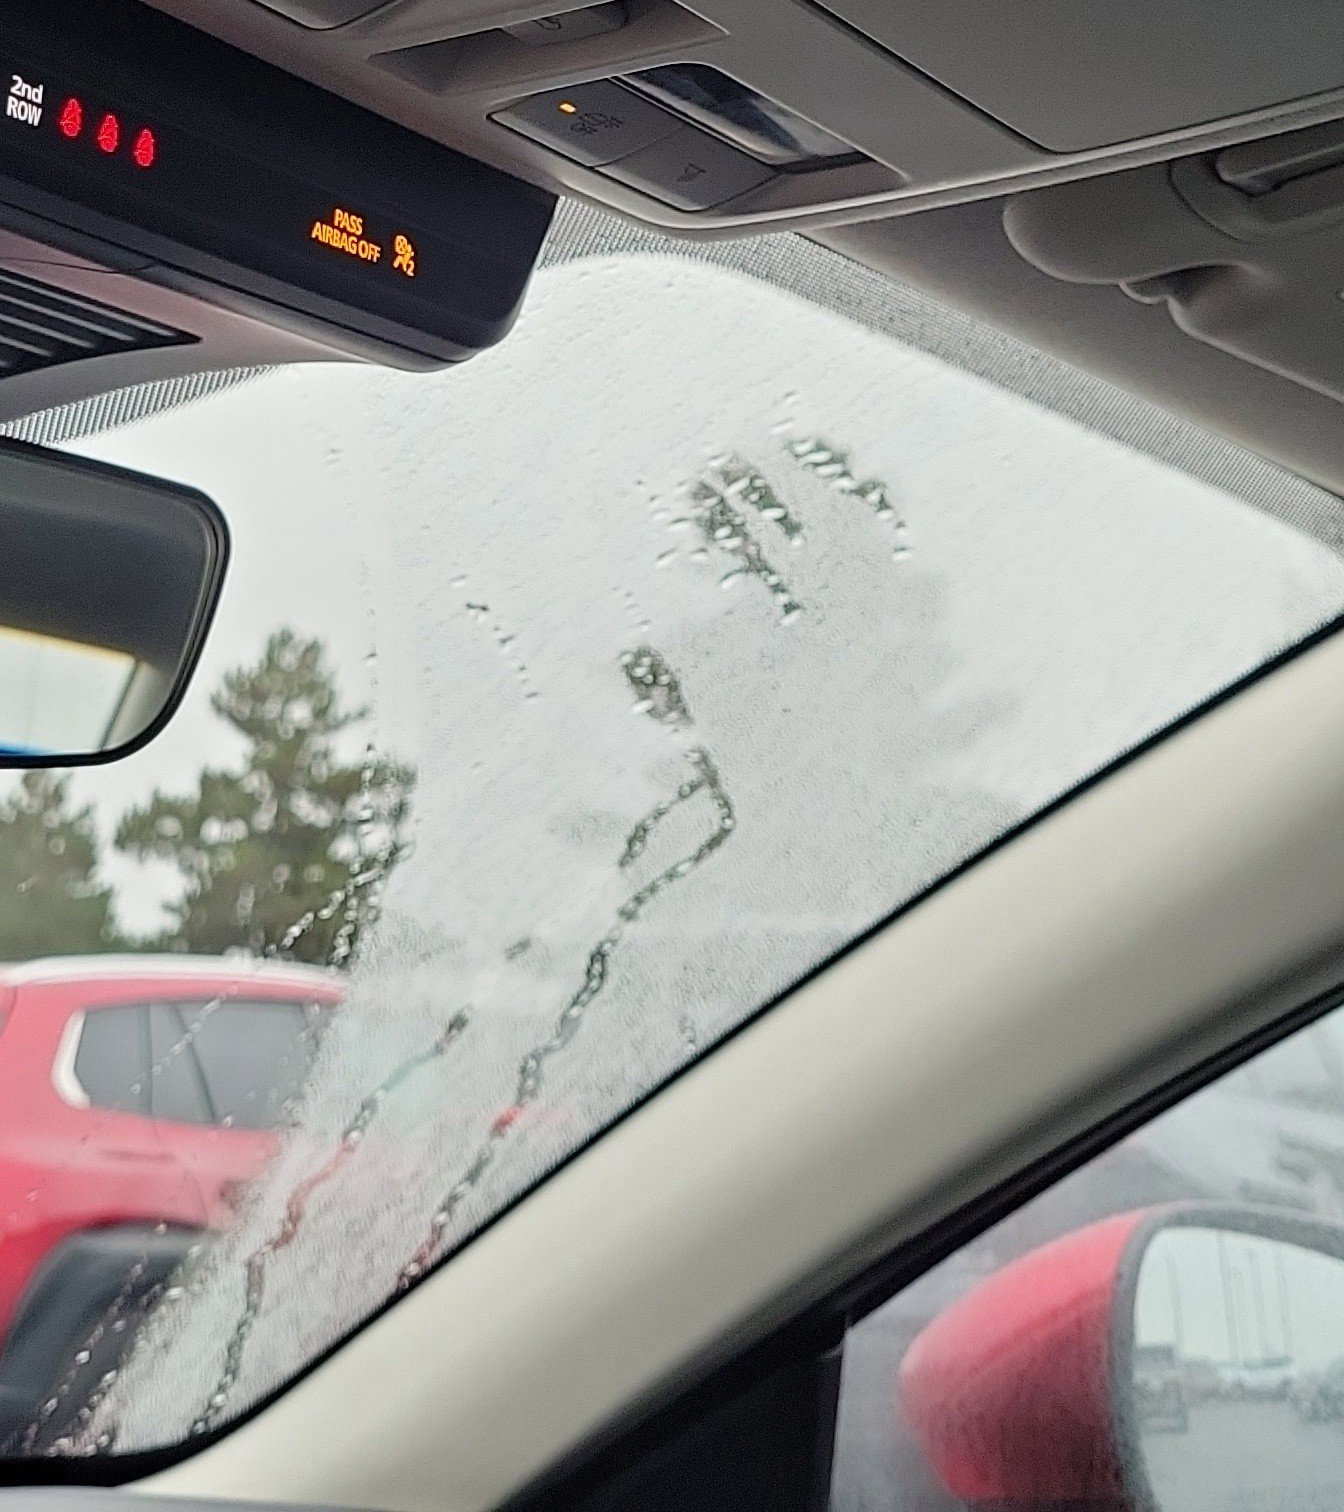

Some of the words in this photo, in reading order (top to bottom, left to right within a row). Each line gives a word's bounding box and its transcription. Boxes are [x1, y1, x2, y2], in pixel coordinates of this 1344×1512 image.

[10, 74, 44, 105] 2nd
[6, 95, 43, 127] ROW
[334, 208, 364, 236] PASS
[311, 221, 358, 255] AIRBAG
[358, 239, 381, 263] OFF
